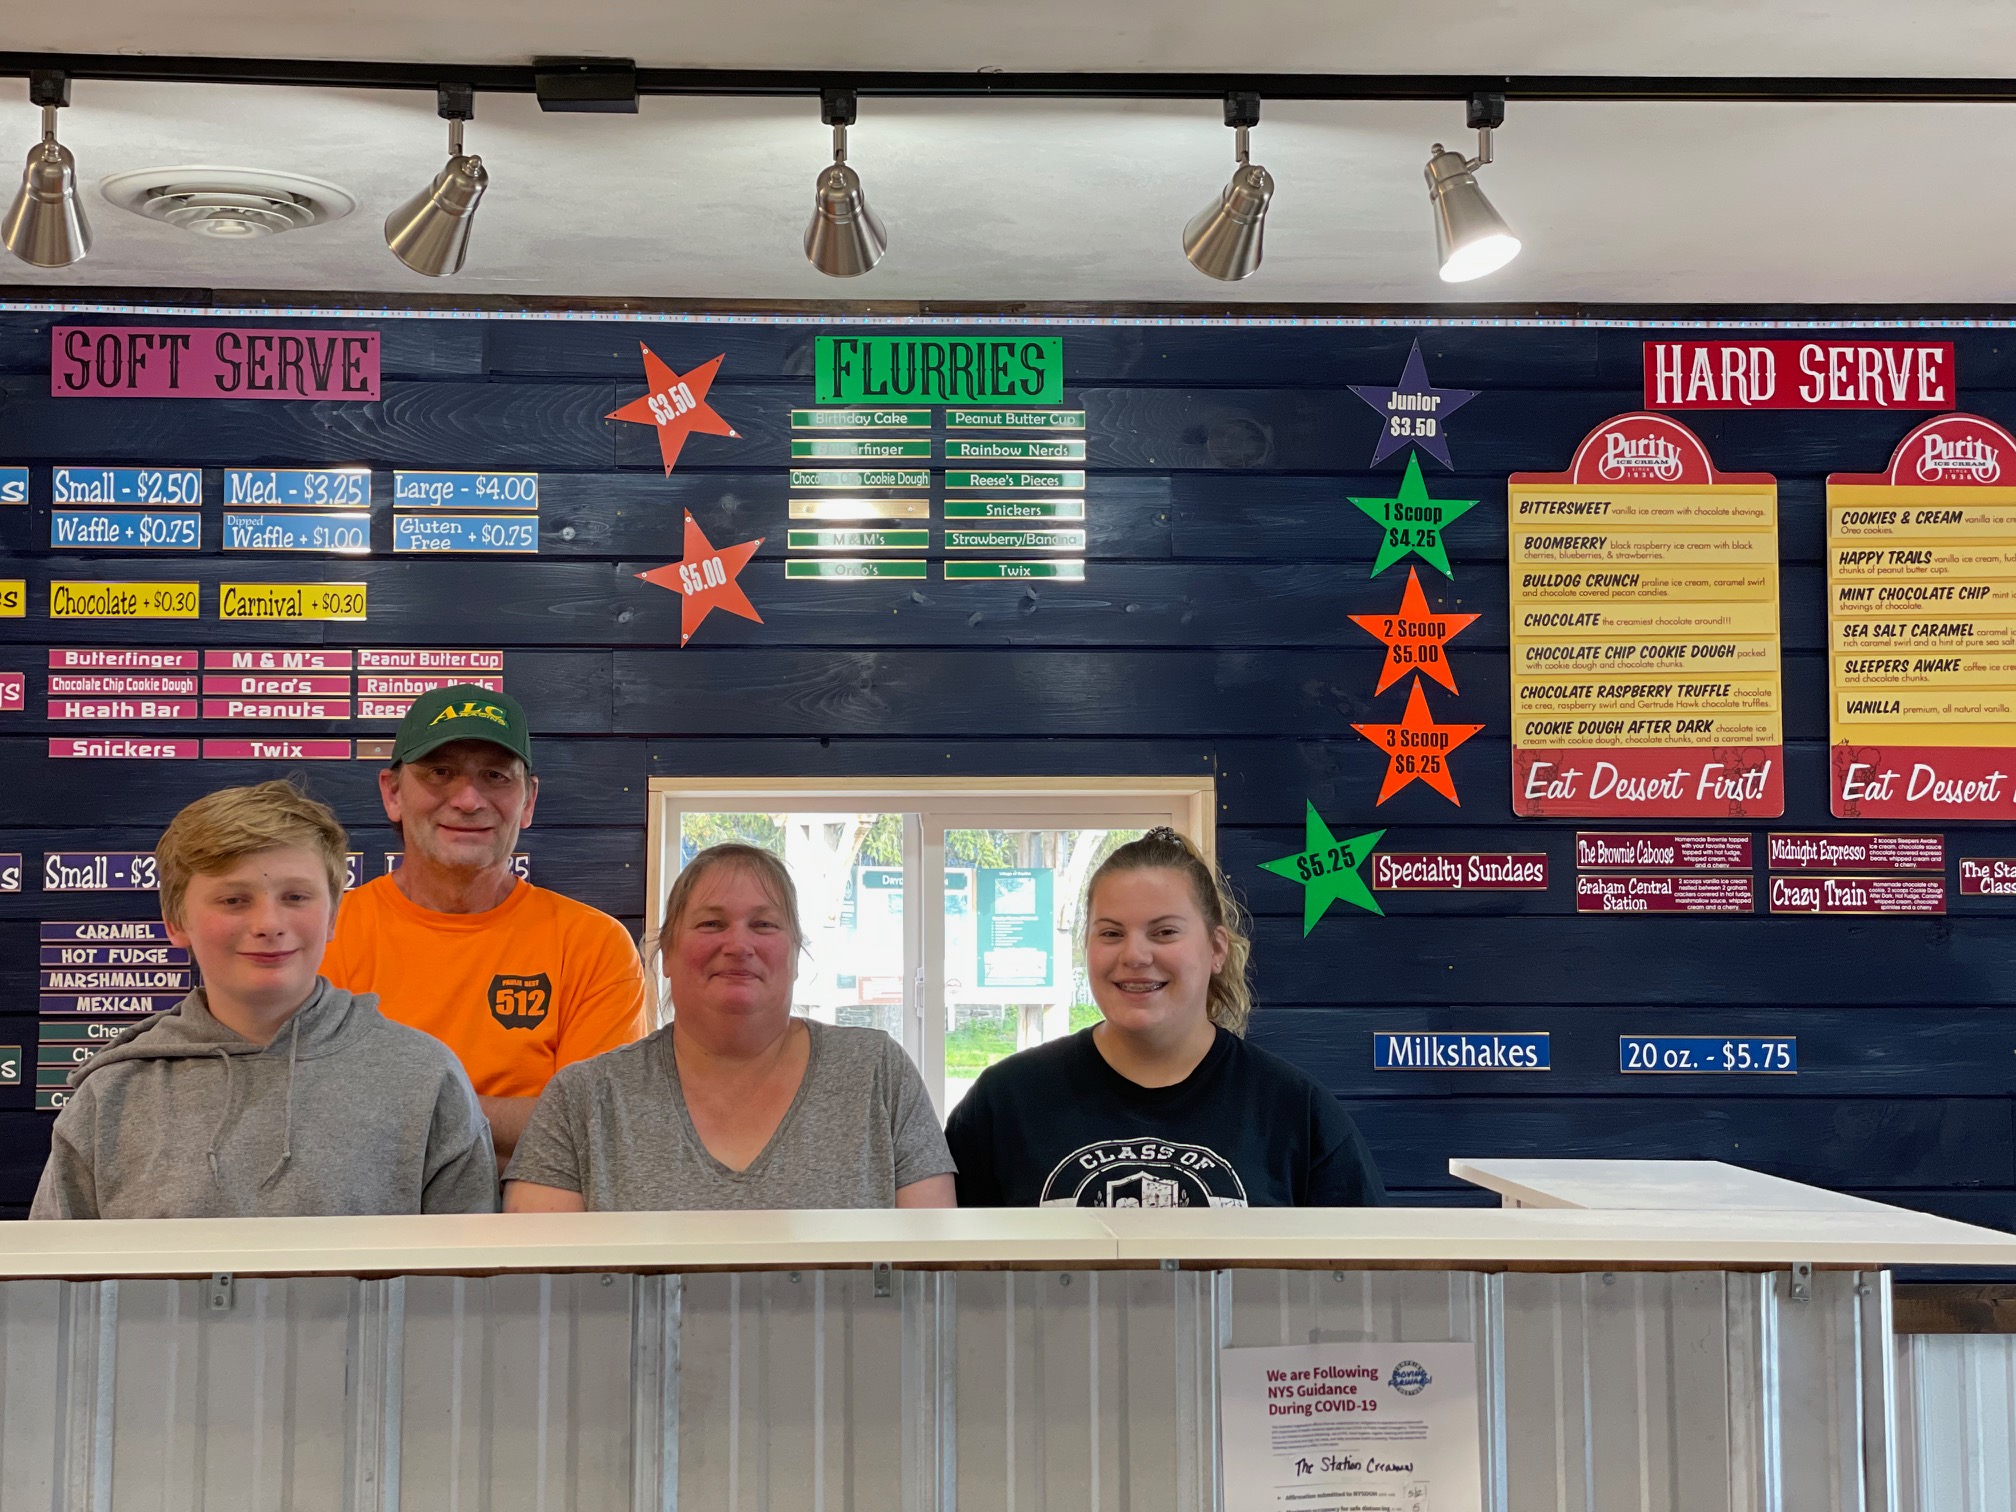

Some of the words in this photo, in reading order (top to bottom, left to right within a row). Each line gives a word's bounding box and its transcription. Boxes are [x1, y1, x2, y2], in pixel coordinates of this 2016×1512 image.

[63, 329, 190, 391] SOFT
[214, 331, 369, 396] SERVE
[832, 338, 1045, 400] FLURRIES
[1655, 343, 1777, 406] HARD
[1798, 343, 1945, 406] SERVE
[647, 381, 697, 427] $3.50
[1388, 391, 1441, 412] Junior
[816, 412, 871, 426] Birthday
[874, 412, 908, 424] Cake
[955, 413, 1002, 425] Peanut
[1006, 413, 1050, 425] Butter
[1053, 413, 1076, 427] Cup
[1391, 416, 1436, 437] $3.50
[961, 444, 1021, 456] Rainbow
[1028, 444, 1069, 456] Nerds
[1600, 432, 1682, 476] Purity
[1917, 434, 2000, 478] Purity
[55, 470, 115, 503] Small
[137, 470, 199, 505] $2.50
[864, 472, 895, 484] Cookie
[897, 472, 929, 486] Dough
[970, 474, 1014, 487] Reese's
[1021, 474, 1059, 487] Pieces
[230, 472, 282, 504] Med.
[304, 473, 363, 505] $3.25
[395, 475, 454, 506] Large
[475, 475, 536, 502] $4.00
[986, 504, 1042, 516] Snickers
[1384, 503, 1390, 520] 1
[1394, 502, 1442, 524] Scoop
[1519, 501, 1611, 515] BITTERSWEET
[1611, 507, 1636, 516] vanilla
[1694, 507, 1729, 516] chocolate
[1731, 507, 1766, 518] shavings.
[1841, 511, 1897, 525] COOKIES
[1915, 510, 1963, 524] CREAM
[1964, 515, 1990, 524] vanilla
[57, 517, 120, 544] Waffle
[139, 515, 196, 545] $0.75
[227, 515, 264, 528] Dipped
[232, 526, 294, 548] Waffle
[313, 527, 363, 549] $1.00
[400, 518, 462, 536] Gluten
[481, 523, 533, 548] $0.75
[1389, 527, 1436, 548] $4.25
[1841, 526, 1861, 535] Oreo
[410, 535, 451, 551] Free
[952, 533, 1077, 548] Strawberry/Banana
[1524, 536, 1607, 550] BOOMBERRY
[1610, 541, 1632, 550] black
[1633, 541, 1671, 551] raspberry
[1839, 551, 1884, 565] HAPPY
[1888, 550, 1932, 564] TRAILS
[679, 555, 727, 596] $5.00
[835, 564, 879, 576] Oreo's
[999, 564, 1031, 577] Twix
[1522, 574, 1581, 588] BULLDOG
[1585, 574, 1640, 587] CRUNCH
[53, 586, 138, 616] Chocolate
[155, 590, 196, 613] $0.30
[1839, 588, 1874, 601] MINT
[1878, 586, 1955, 600] CHOCOLATE
[1958, 586, 1990, 600] CHIP
[223, 589, 303, 617] Carnival
[322, 591, 364, 614] $0.30
[1524, 613, 1601, 627] CHOCOLATE
[1655, 616, 1693, 626] chocolate
[1384, 619, 1394, 638] 2
[1397, 619, 1447, 640] Scoop
[1843, 624, 1868, 638] SEA
[1872, 624, 1907, 637] SALT
[1911, 623, 1974, 637] CARAMEL
[65, 652, 183, 669] Butterfinger
[282, 652, 324, 668] M's
[361, 652, 415, 668] Peanut
[419, 652, 466, 668] Butter
[469, 653, 499, 670] Cup
[1392, 644, 1439, 665] $5.00
[1525, 646, 1601, 660] CHOCOLATE
[1604, 645, 1636, 659] CHIP
[1640, 645, 1687, 659] COOKIE
[1690, 645, 1736, 658] DOUGH
[1844, 659, 1910, 673] SLEEPERS
[1913, 658, 1961, 672] AWAKE
[52, 677, 101, 692] Chocolate
[103, 677, 124, 694] Chip
[126, 677, 160, 692] Cookie
[162, 677, 193, 695] Dough
[241, 677, 312, 694] Oreo's
[367, 679, 438, 693] Rainbow
[1520, 685, 1593, 699] CHOCOLATE
[1596, 684, 1672, 698] RASPBERRY
[1677, 683, 1731, 697] TRUFFLE
[65, 702, 137, 718] Heath
[142, 702, 181, 719] Bar
[228, 701, 325, 718] Peanuts
[1557, 701, 1597, 711] raspberry
[1637, 699, 1674, 709] Gertrude
[1676, 699, 1700, 709] Hawk
[1846, 700, 1900, 714] VANILLA
[429, 702, 503, 727] ALC
[458, 711, 506, 726] RACING
[1525, 721, 1574, 735] COOKIE
[1577, 720, 1624, 734] DOUGH
[1627, 720, 1671, 734] AFTER
[1675, 719, 1714, 733] DARK
[1386, 729, 1396, 747] 3
[1400, 729, 1449, 751] Scoop
[72, 740, 176, 758] Snickers
[251, 742, 303, 758] Twix
[1395, 754, 1440, 775] $6.25
[1524, 761, 1584, 799] Eat
[1589, 761, 1691, 801] Dessert
[1696, 760, 1772, 801] First!
[1842, 763, 1901, 801] Eat
[1906, 763, 2008, 804] Dessert
[1597, 840, 1635, 864] Brownie
[1637, 840, 1674, 864] Caboose
[1771, 839, 1818, 867] Midnight
[1819, 840, 1866, 866] Expresso
[45, 855, 108, 888] Small
[1296, 844, 1356, 882] $5.25
[1962, 861, 1989, 877] The
[1379, 855, 1462, 889] Specialty
[1468, 855, 1543, 882] Sundaes
[1578, 878, 1625, 895] Graham
[1628, 878, 1672, 894] Central
[1603, 894, 1647, 911] Station
[1773, 879, 1820, 912] Crazy
[1824, 880, 1868, 906] Train
[75, 924, 155, 940] CARAMEL
[61, 948, 98, 964] HOT
[108, 949, 168, 964] FUDGE
[49, 973, 182, 988] MARSHMALLOW
[76, 996, 153, 1011] MEXICAN
[495, 988, 546, 1016] 512
[1388, 1036, 1538, 1067] Milkshakes
[1628, 1043, 1657, 1068] 20
[1663, 1048, 1698, 1068] oz.
[1722, 1041, 1790, 1071] $5.75
[1079, 1144, 1175, 1170] CLASS
[1180, 1151, 1215, 1171] OF
[1267, 1369, 1287, 1382] We
[1290, 1370, 1311, 1380] are
[1313, 1365, 1379, 1381] Following
[1268, 1386, 1294, 1399] NYS
[1297, 1383, 1357, 1397] Guidance
[1269, 1402, 1313, 1417] During
[1315, 1400, 1377, 1413] COVID-19
[1320, 1455, 1361, 1472] Station
